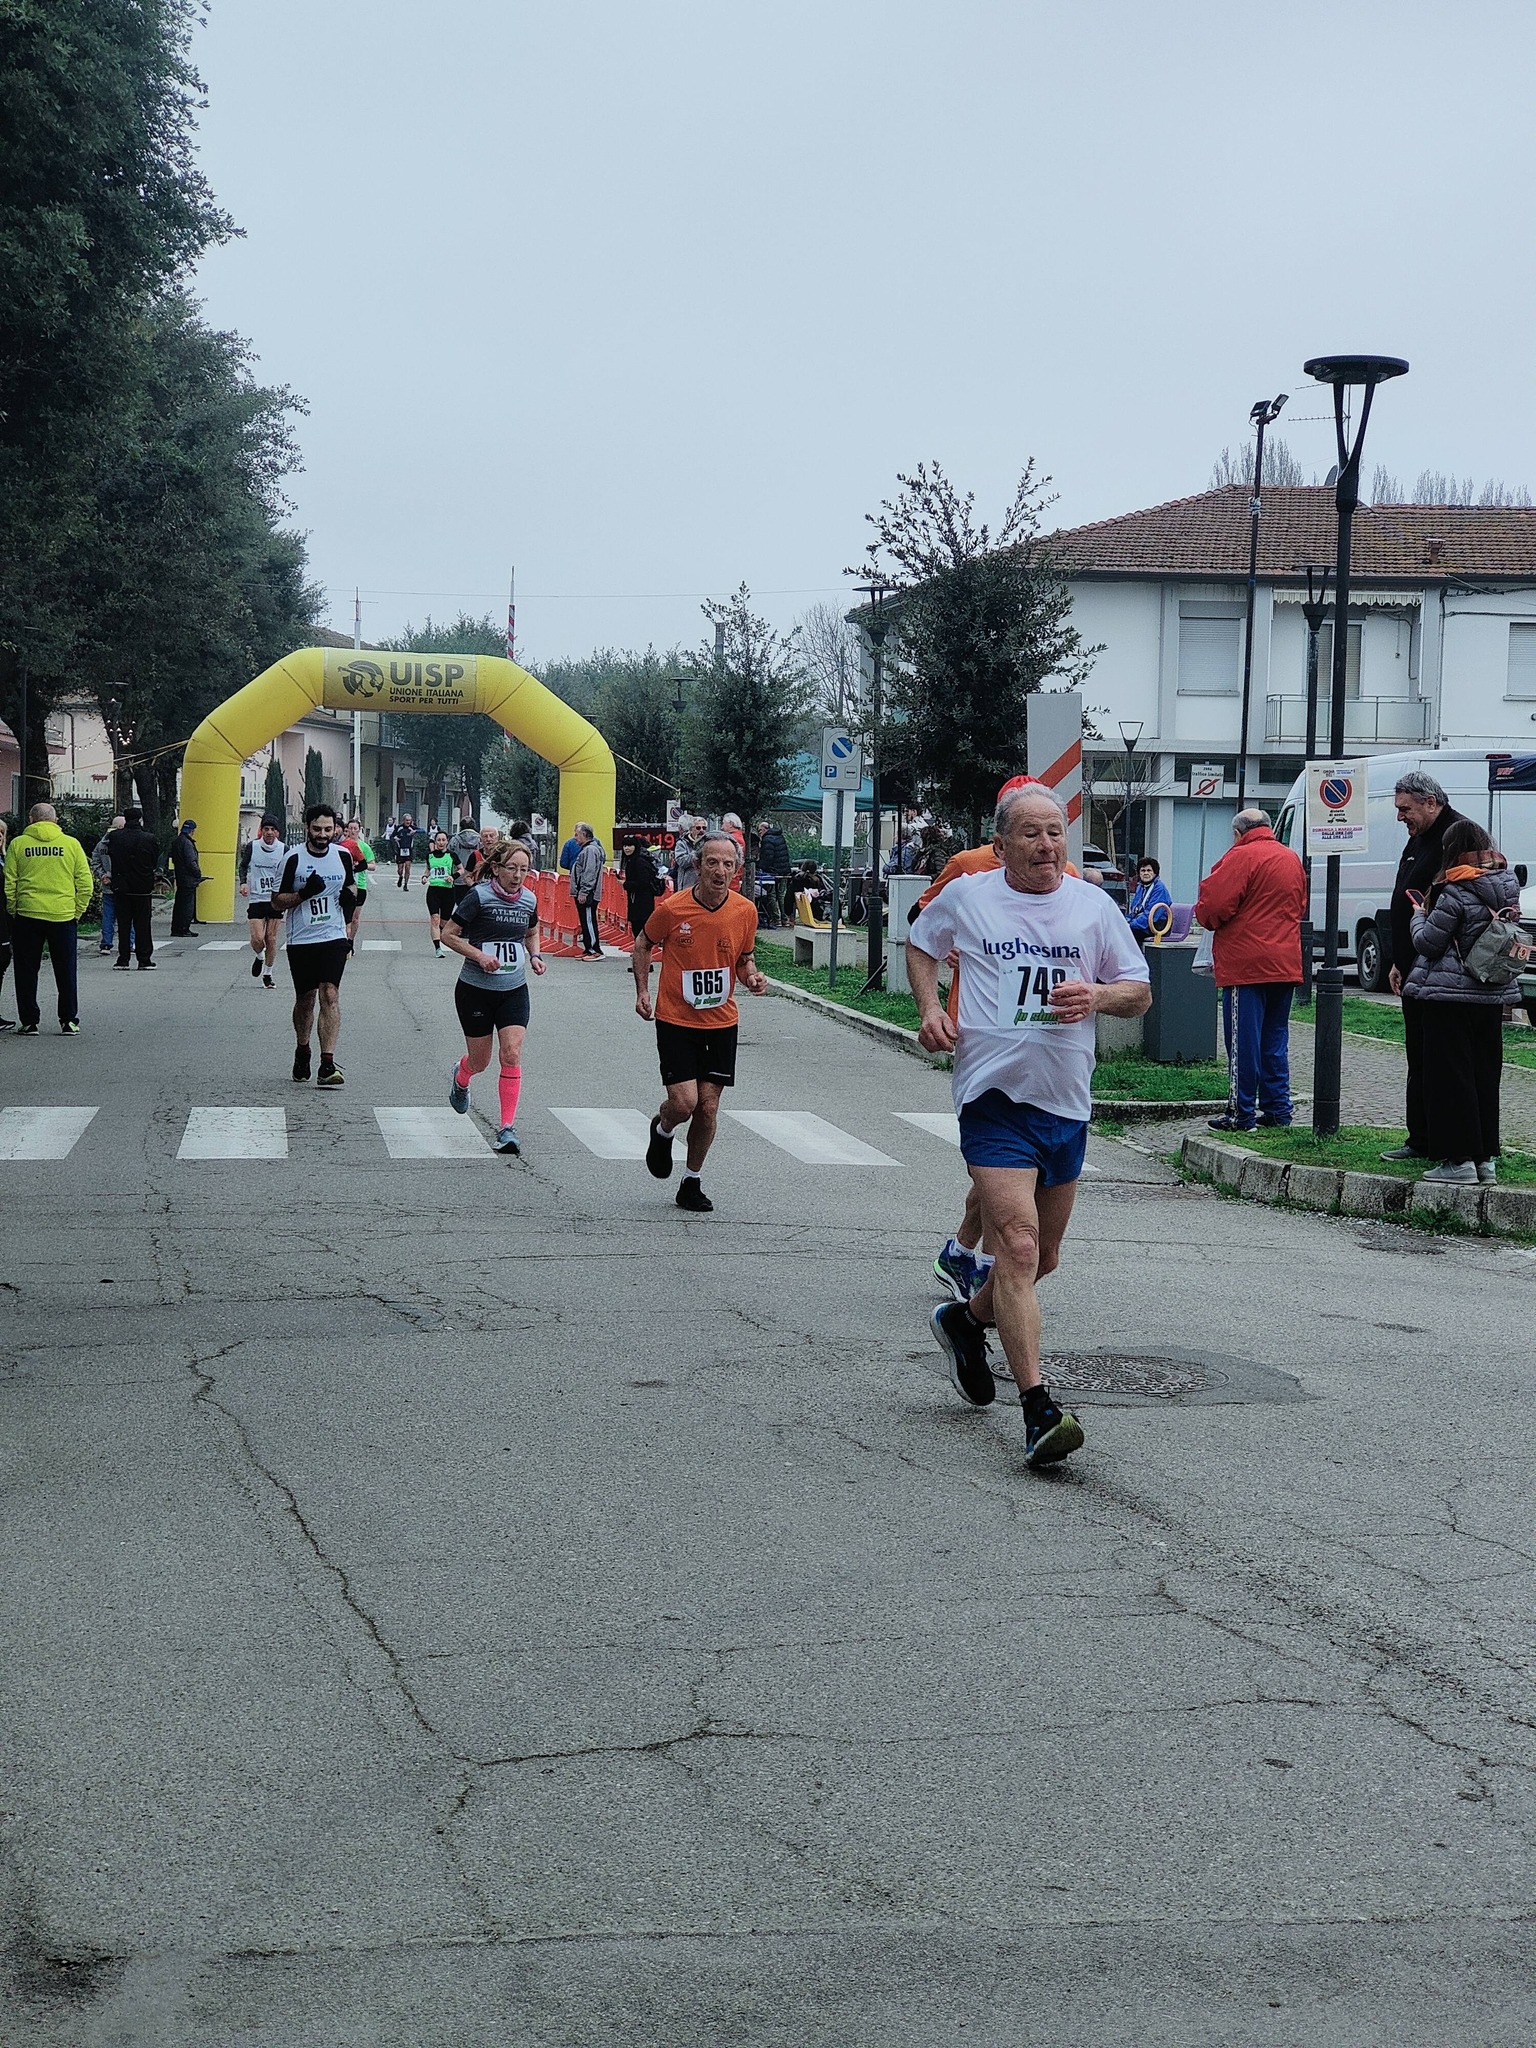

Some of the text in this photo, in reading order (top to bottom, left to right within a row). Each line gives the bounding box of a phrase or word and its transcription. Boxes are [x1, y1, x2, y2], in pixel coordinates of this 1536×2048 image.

[390, 661, 464, 687] UISP
[389, 695, 415, 704] SPORT
[418, 696, 434, 704] PER
[390, 687, 464, 697] UNIONE ITALIANA
[826, 766, 835, 777] P
[25, 846, 64, 857] GIUDICE
[309, 896, 329, 916] 617
[493, 942, 518, 963] 719
[982, 938, 1081, 960] lughesina
[692, 970, 723, 996] 665
